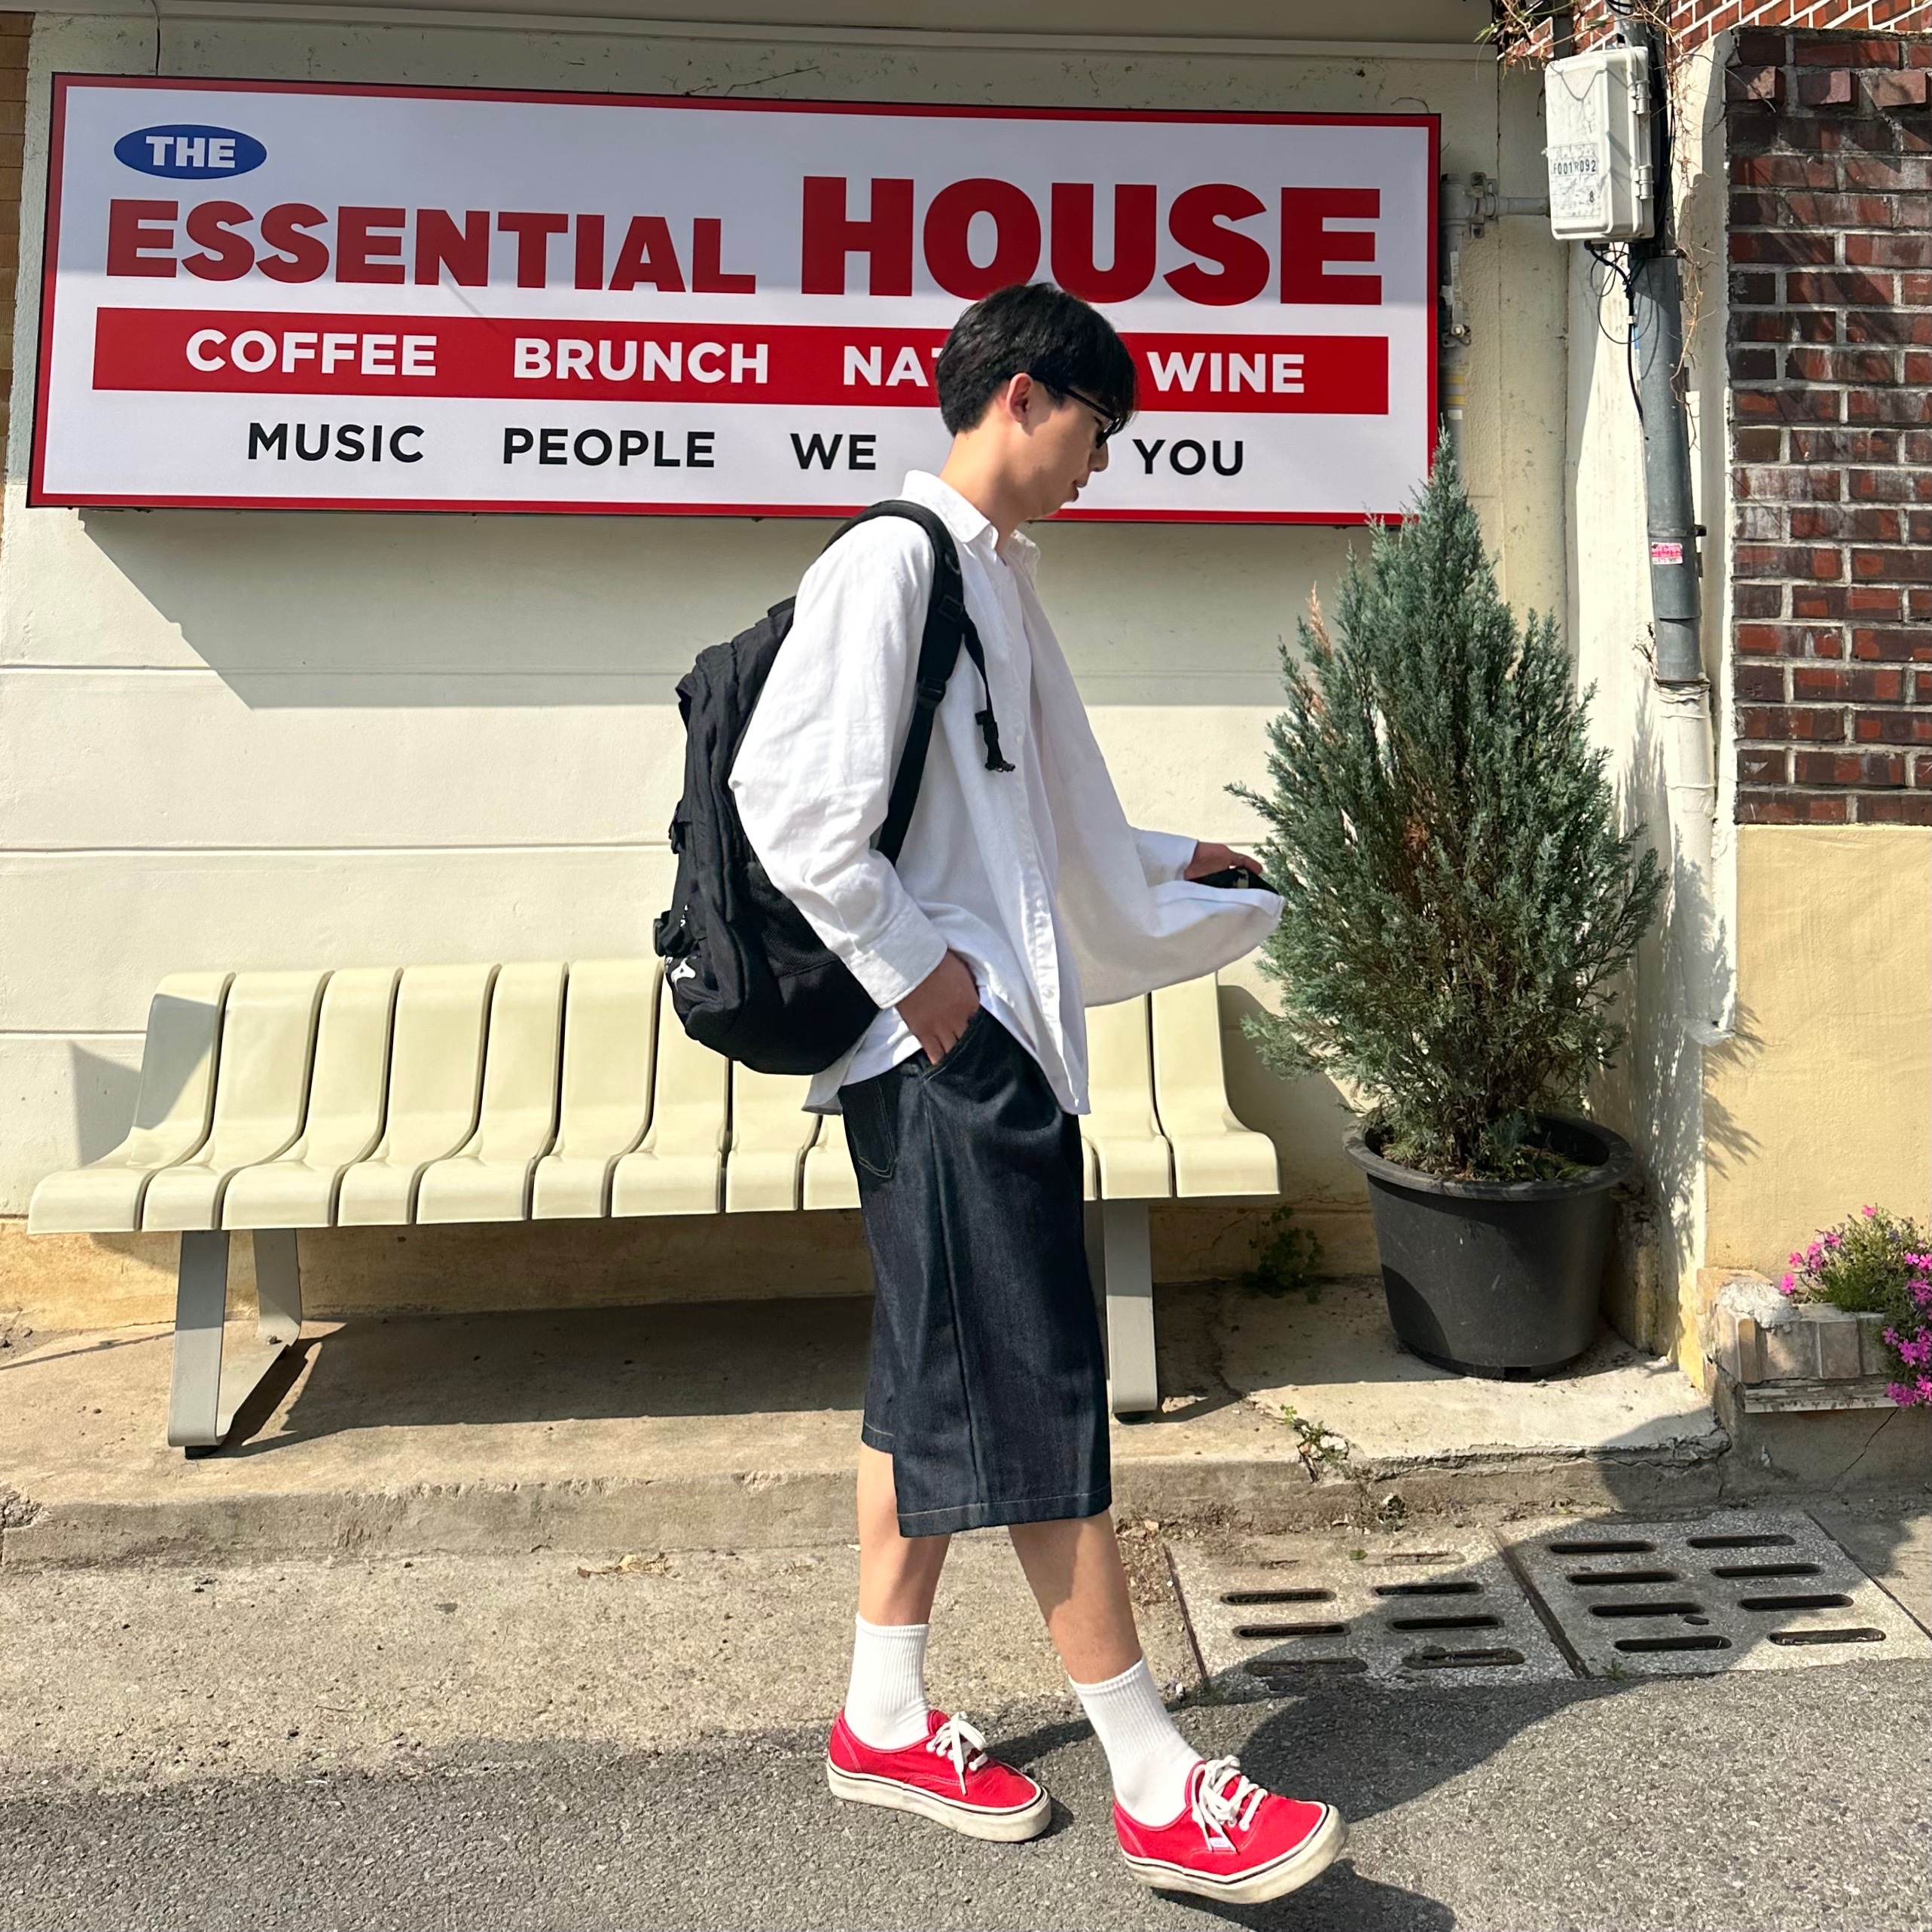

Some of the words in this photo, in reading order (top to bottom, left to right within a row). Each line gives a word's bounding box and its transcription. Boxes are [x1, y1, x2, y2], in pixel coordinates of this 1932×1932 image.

[146, 136, 236, 169] THE
[107, 200, 755, 294] ESSENTIAL
[801, 176, 1382, 306] HOUSE
[186, 329, 437, 376] COFFEE
[514, 338, 768, 383] BRUNCH
[1147, 352, 1305, 392] WINE
[249, 423, 425, 462] MUSIC
[503, 428, 715, 468] PEOPLE
[790, 433, 877, 470] WE
[1133, 439, 1244, 476] YOU
